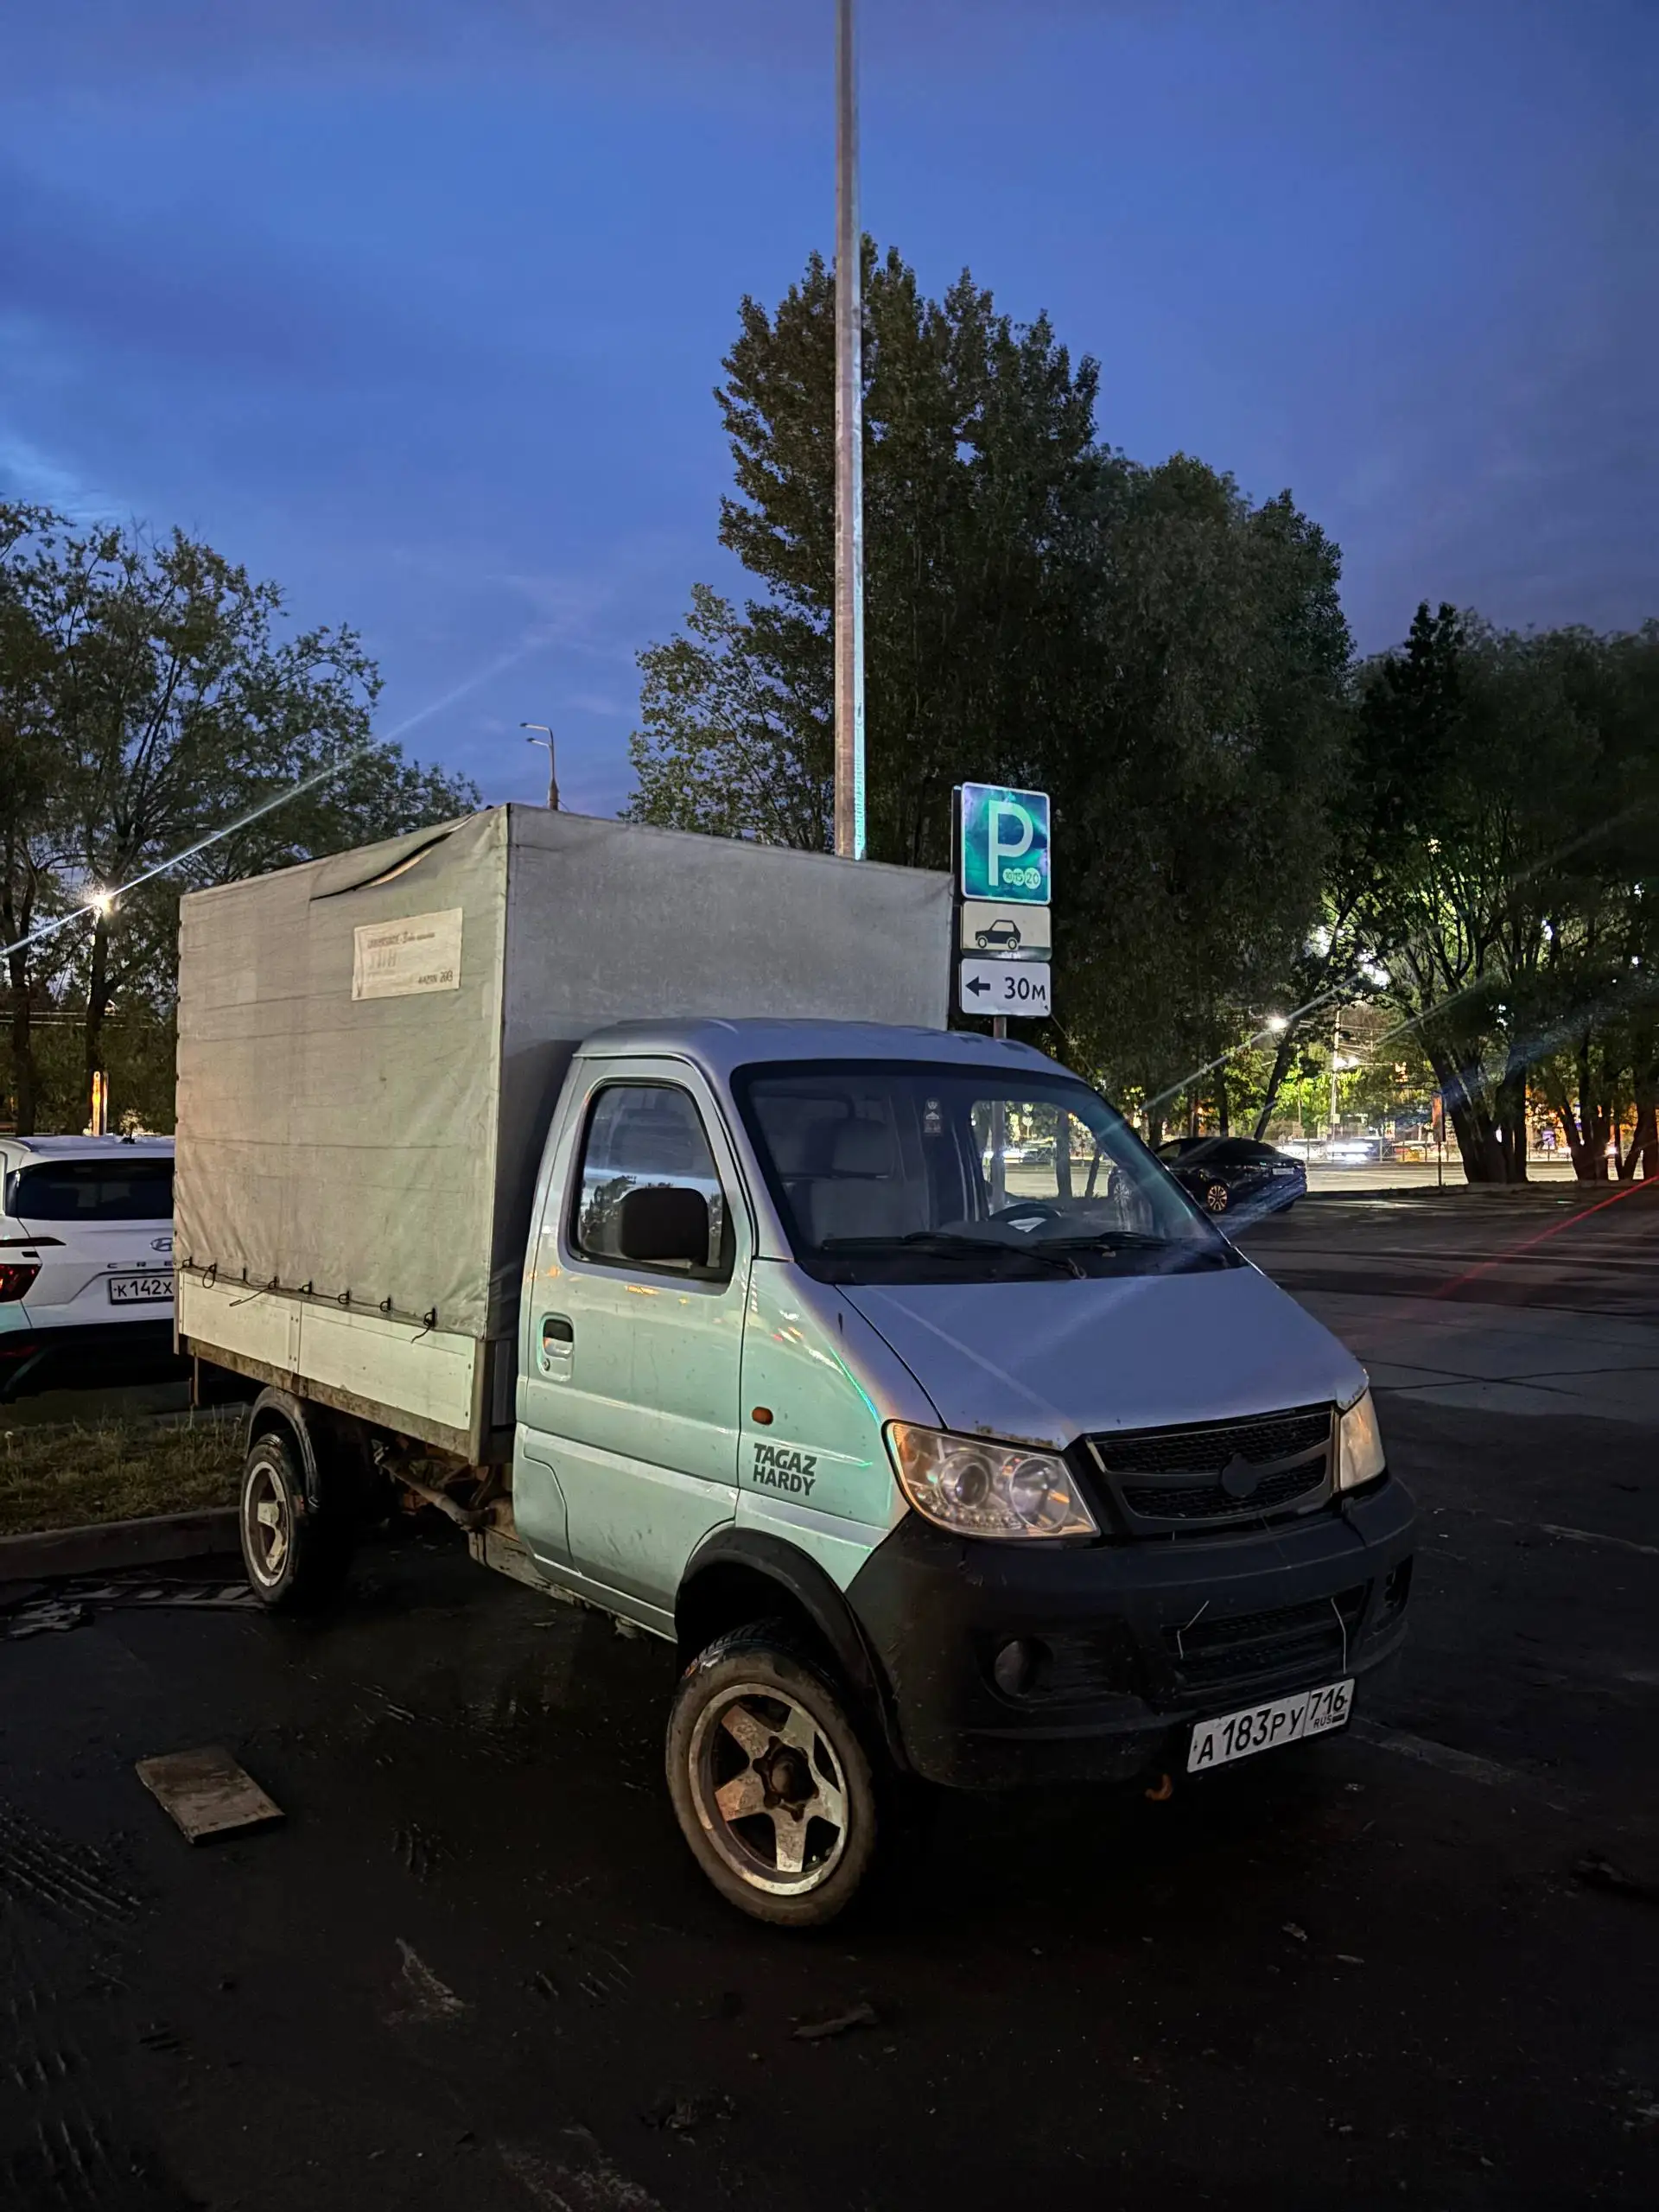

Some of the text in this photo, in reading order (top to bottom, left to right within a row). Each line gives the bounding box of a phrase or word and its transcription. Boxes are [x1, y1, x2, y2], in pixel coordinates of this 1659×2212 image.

[988, 800, 1033, 886] P
[1026, 872, 1039, 885] 20
[753, 1442, 817, 1477] TAGAZ
[753, 1464, 816, 1496] HARDY
[1310, 1685, 1345, 1720] 716
[1313, 1716, 1332, 1728] RUS
